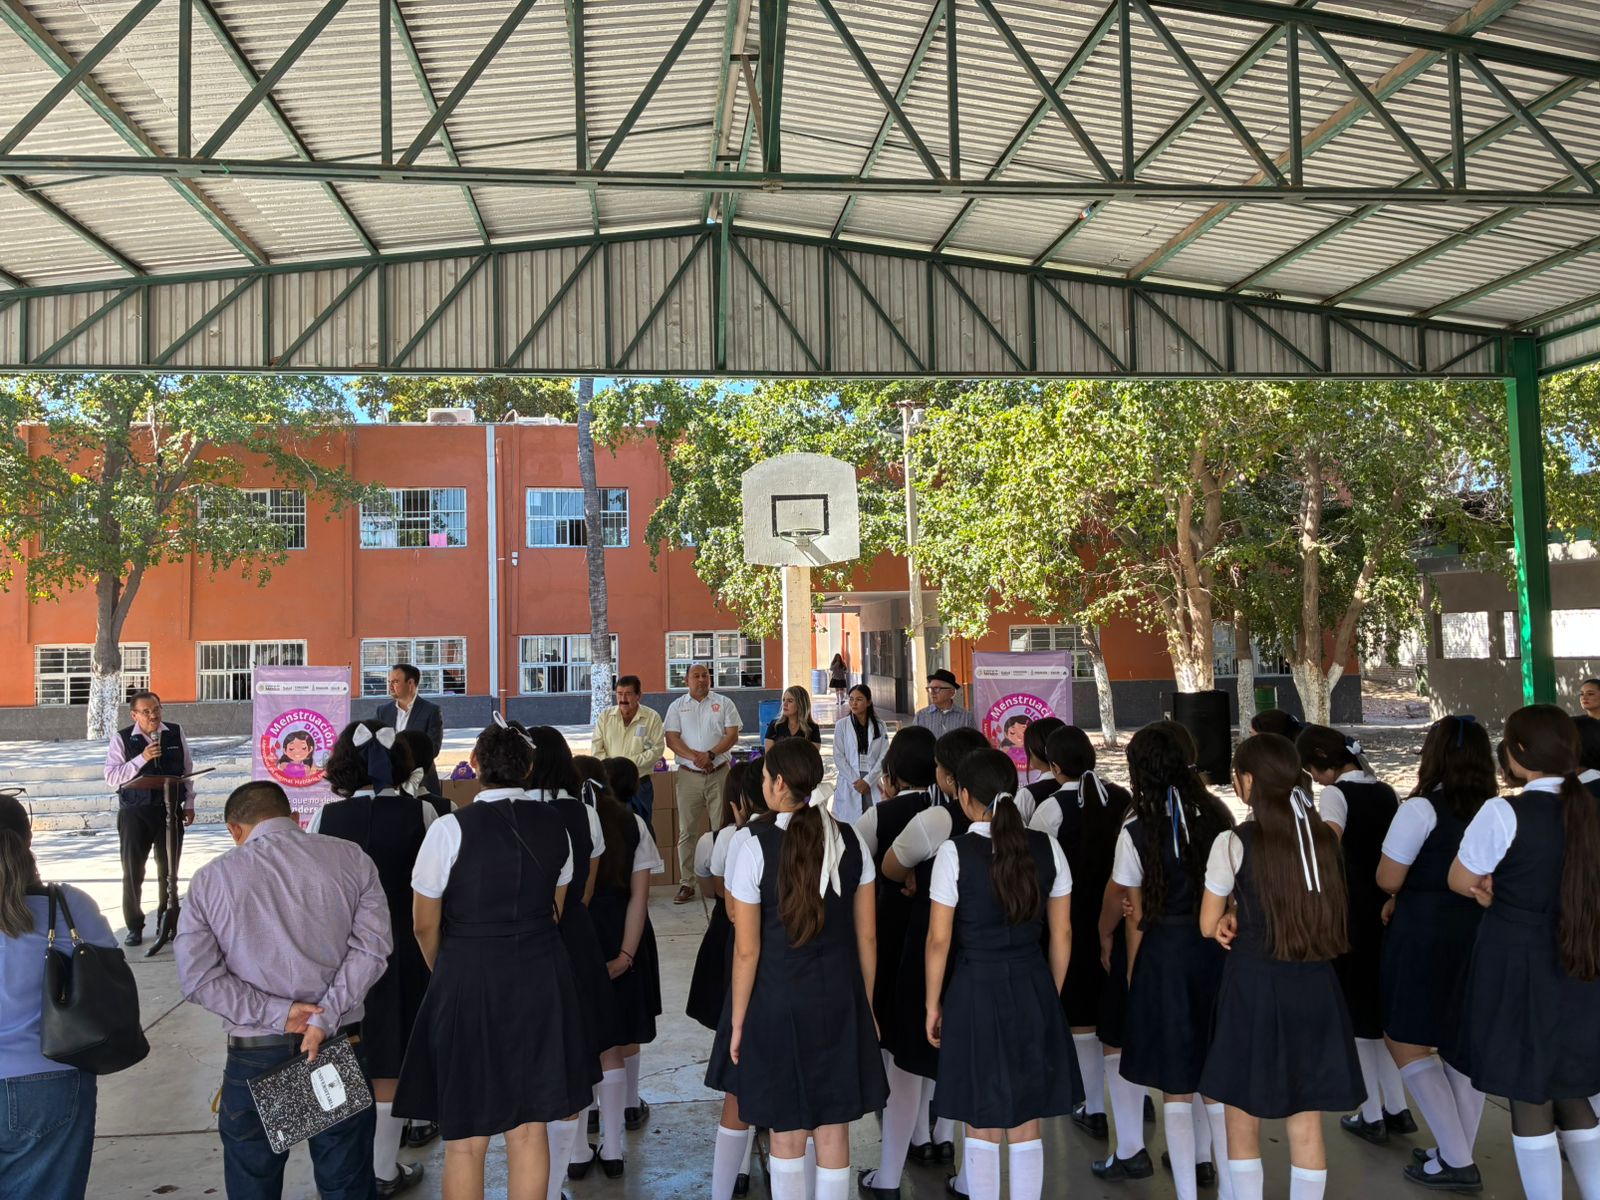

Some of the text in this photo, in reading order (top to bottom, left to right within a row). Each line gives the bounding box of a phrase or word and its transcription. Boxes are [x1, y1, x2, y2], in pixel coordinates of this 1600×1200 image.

[990, 695, 1053, 719] Menstruaci
[270, 711, 334, 747] Menstruación
[304, 723, 322, 752] DIGNA
[292, 798, 307, 807] que
